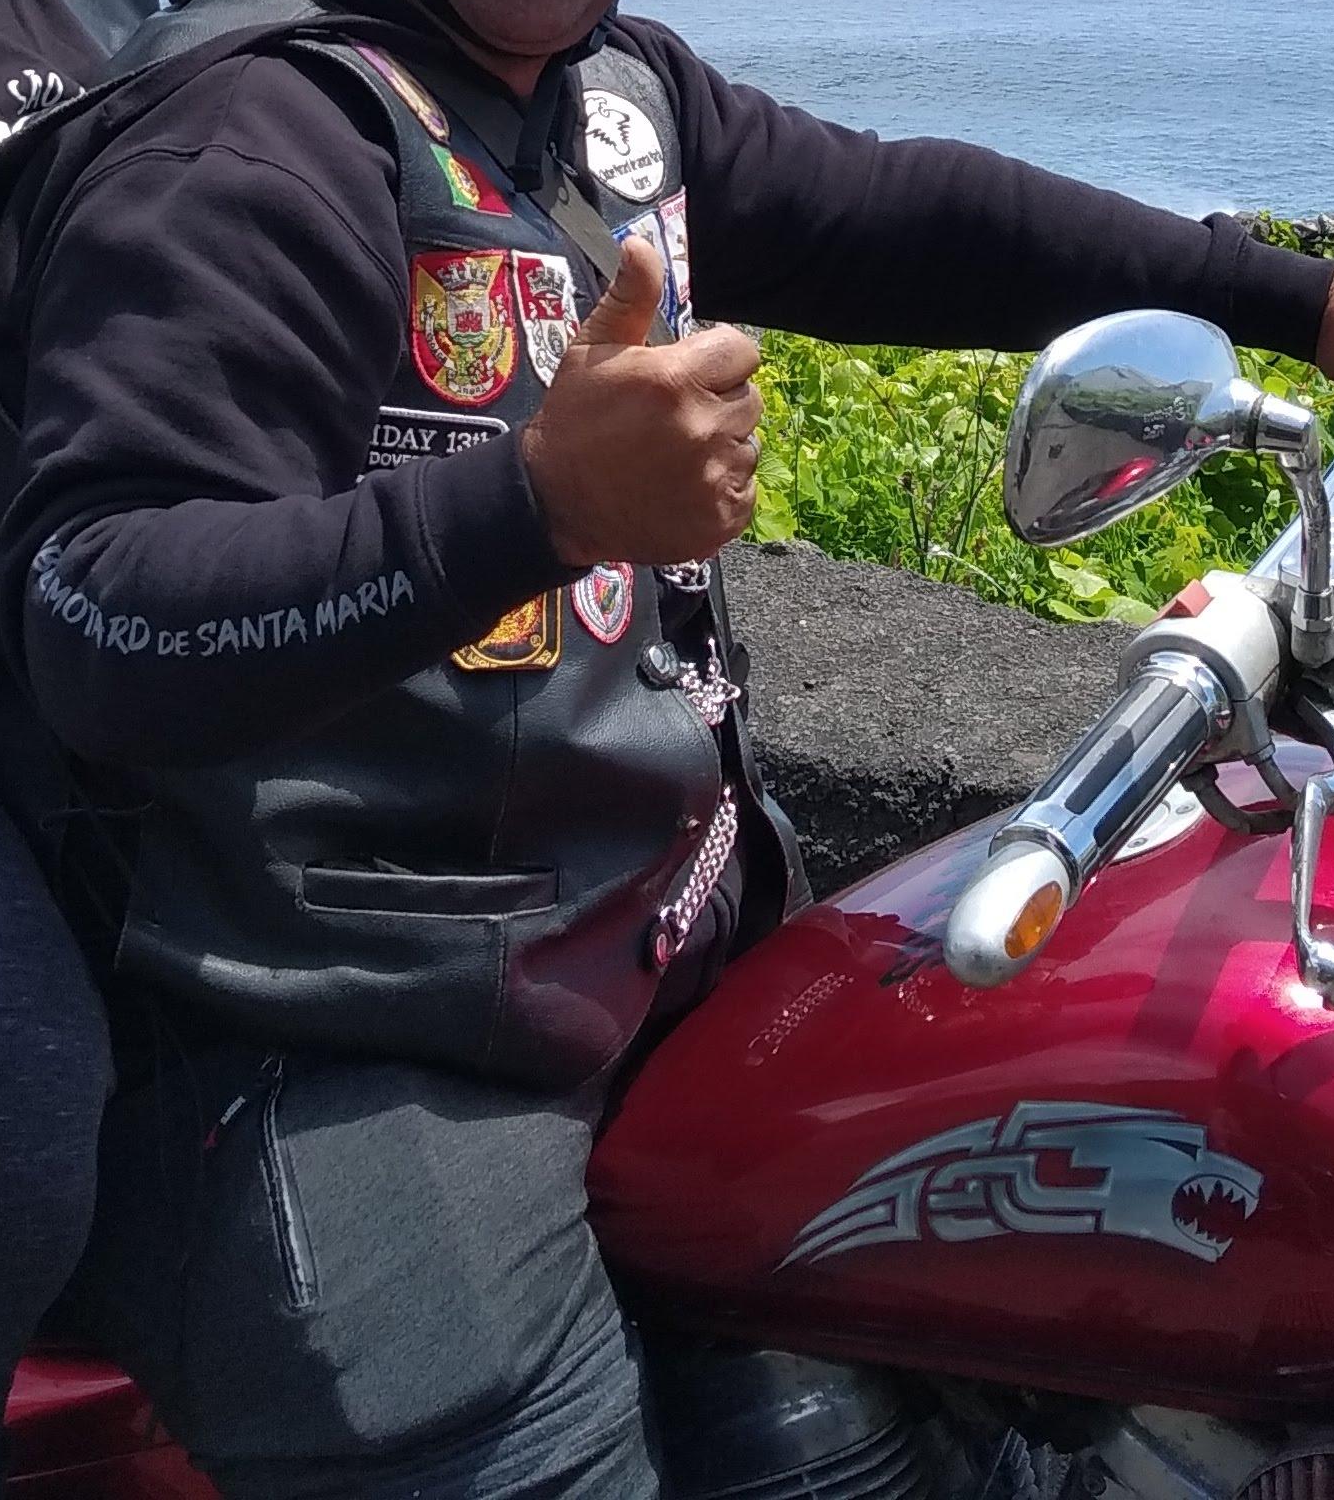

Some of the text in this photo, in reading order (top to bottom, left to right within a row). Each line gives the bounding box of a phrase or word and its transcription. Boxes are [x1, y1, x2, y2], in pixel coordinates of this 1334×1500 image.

[369, 423, 438, 451] IDAY
[369, 451, 420, 467] DOVE
[44, 569, 415, 657] MOTARD DE SANTA MARIA
